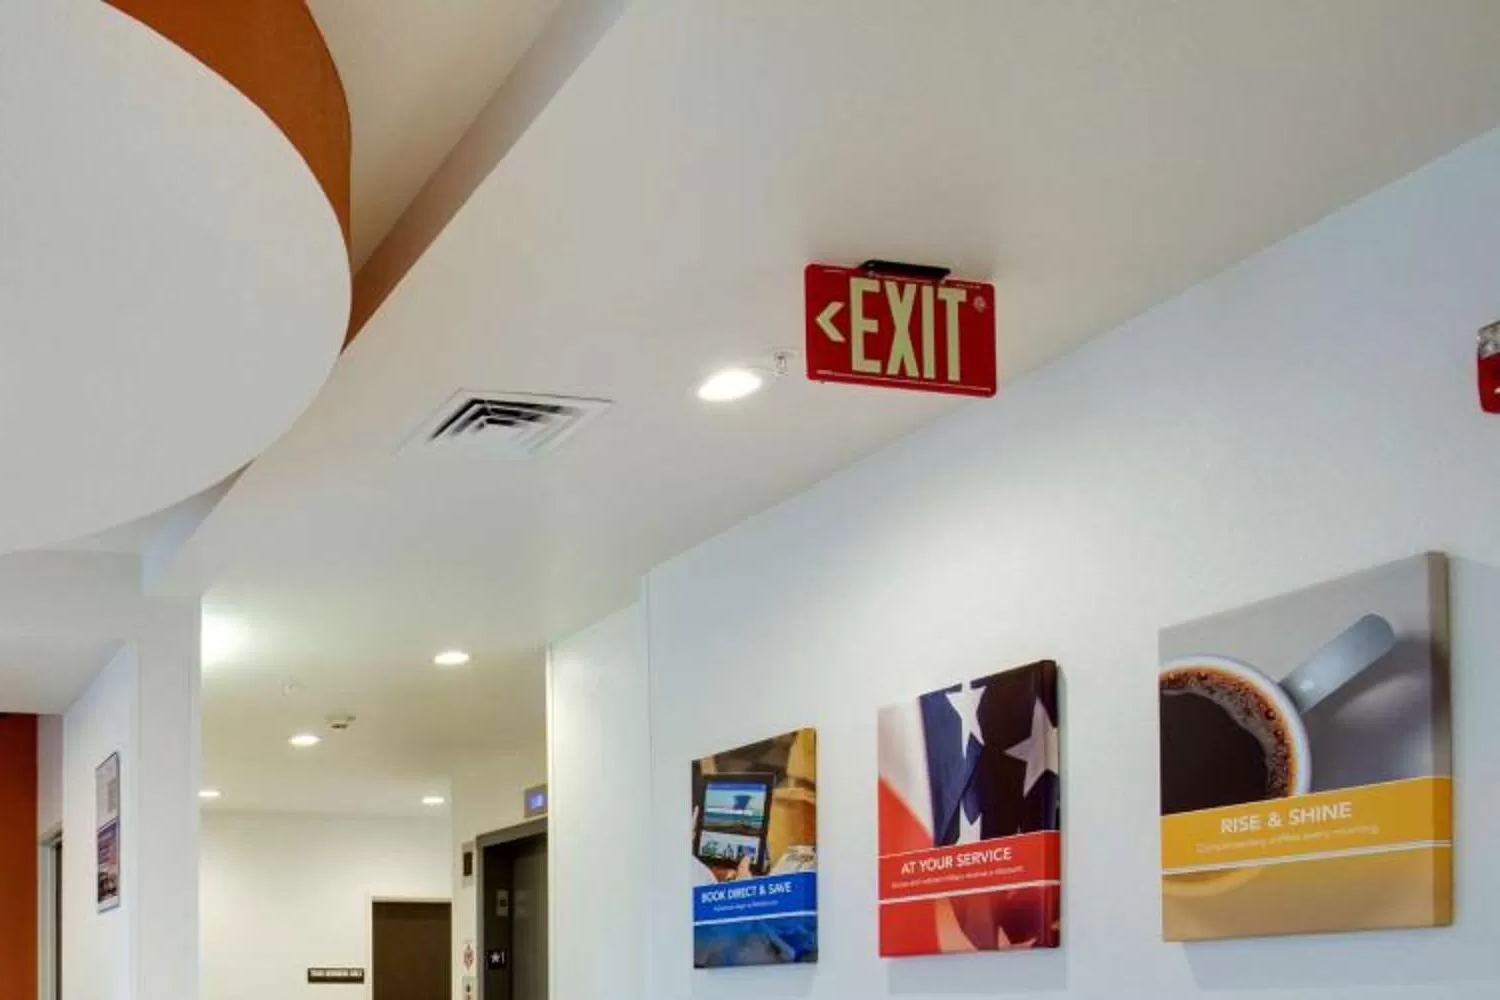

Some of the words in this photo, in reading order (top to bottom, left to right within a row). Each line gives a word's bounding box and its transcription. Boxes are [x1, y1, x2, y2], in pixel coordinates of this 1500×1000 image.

[850, 276, 968, 382] EXIT
[1219, 814, 1261, 833] RISE
[1267, 811, 1282, 828] &
[1288, 801, 1353, 826] SHINE
[901, 860, 916, 875] AT
[919, 855, 953, 873] YOUR
[956, 846, 1013, 868] SERVICE
[768, 881, 793, 895] SAVE
